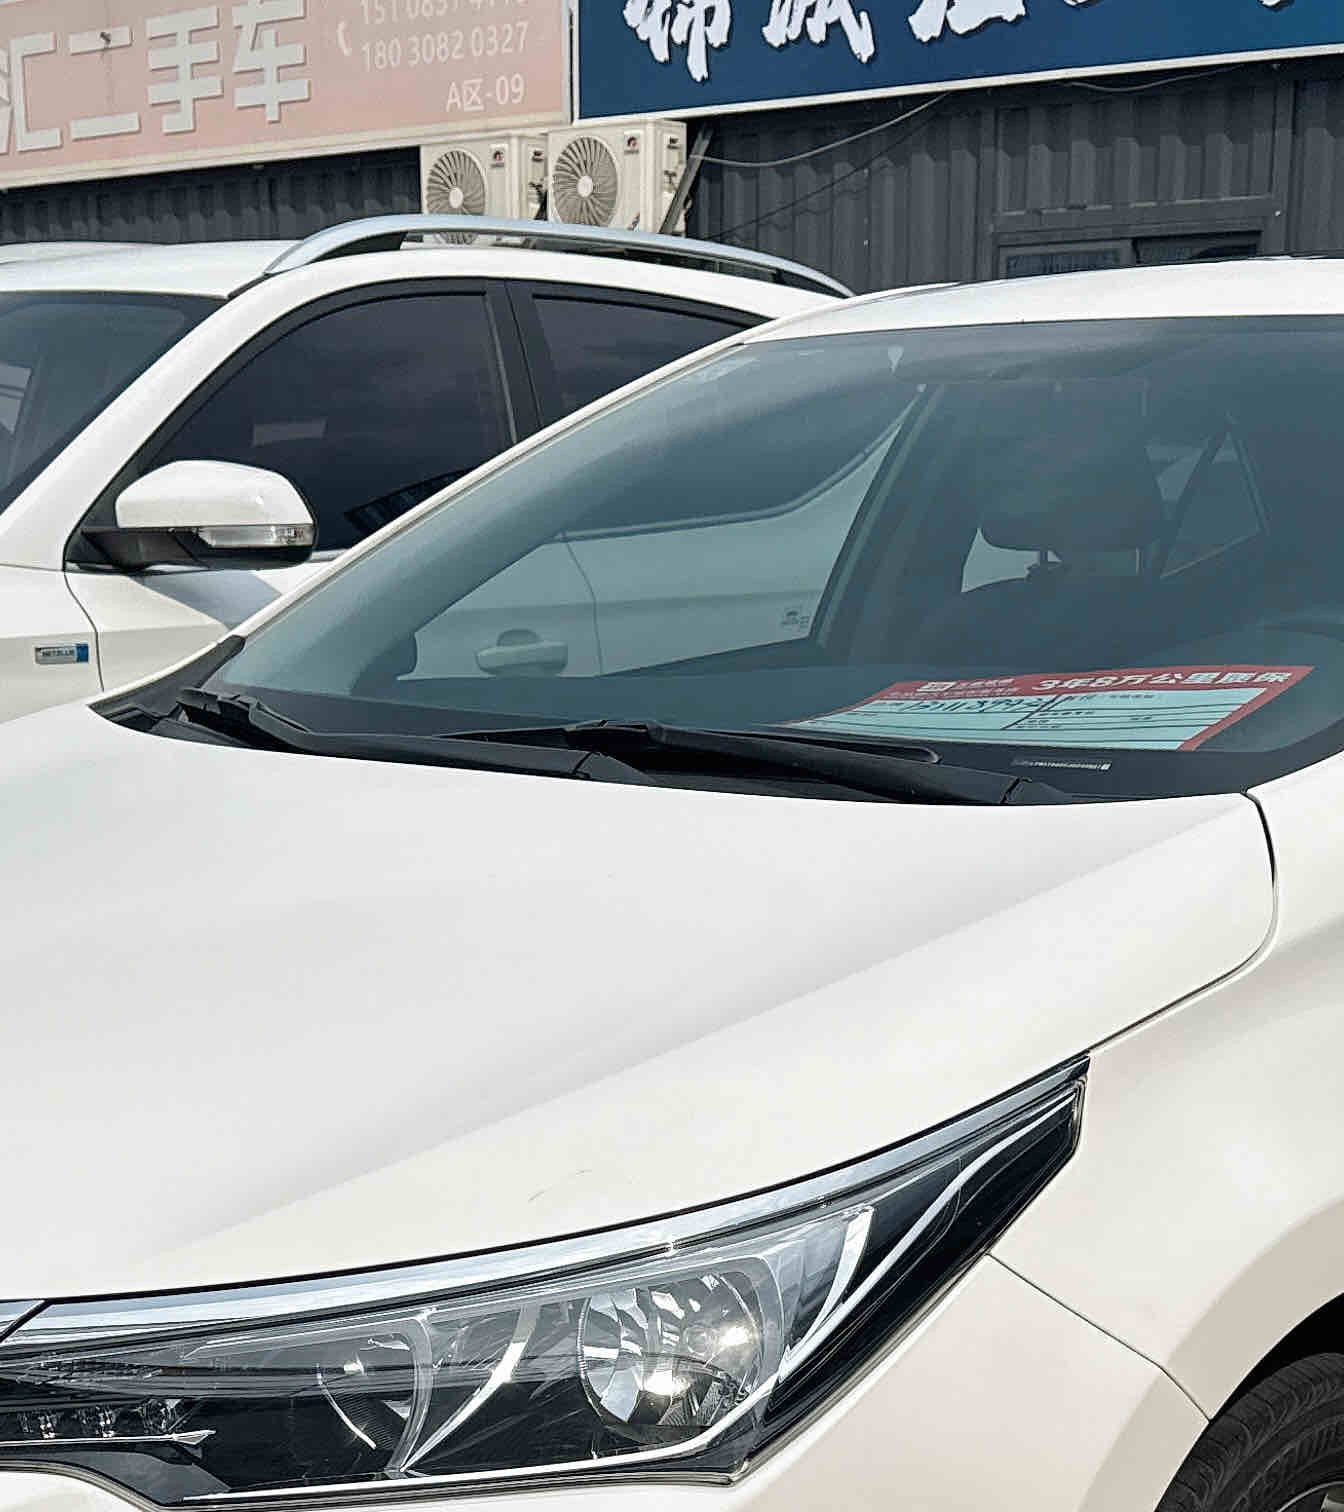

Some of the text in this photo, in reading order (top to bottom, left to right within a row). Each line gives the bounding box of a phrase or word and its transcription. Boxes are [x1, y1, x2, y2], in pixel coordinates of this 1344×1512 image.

[361, 21, 529, 72] 180 3082 0327
[446, 73, 525, 112] A区-09
